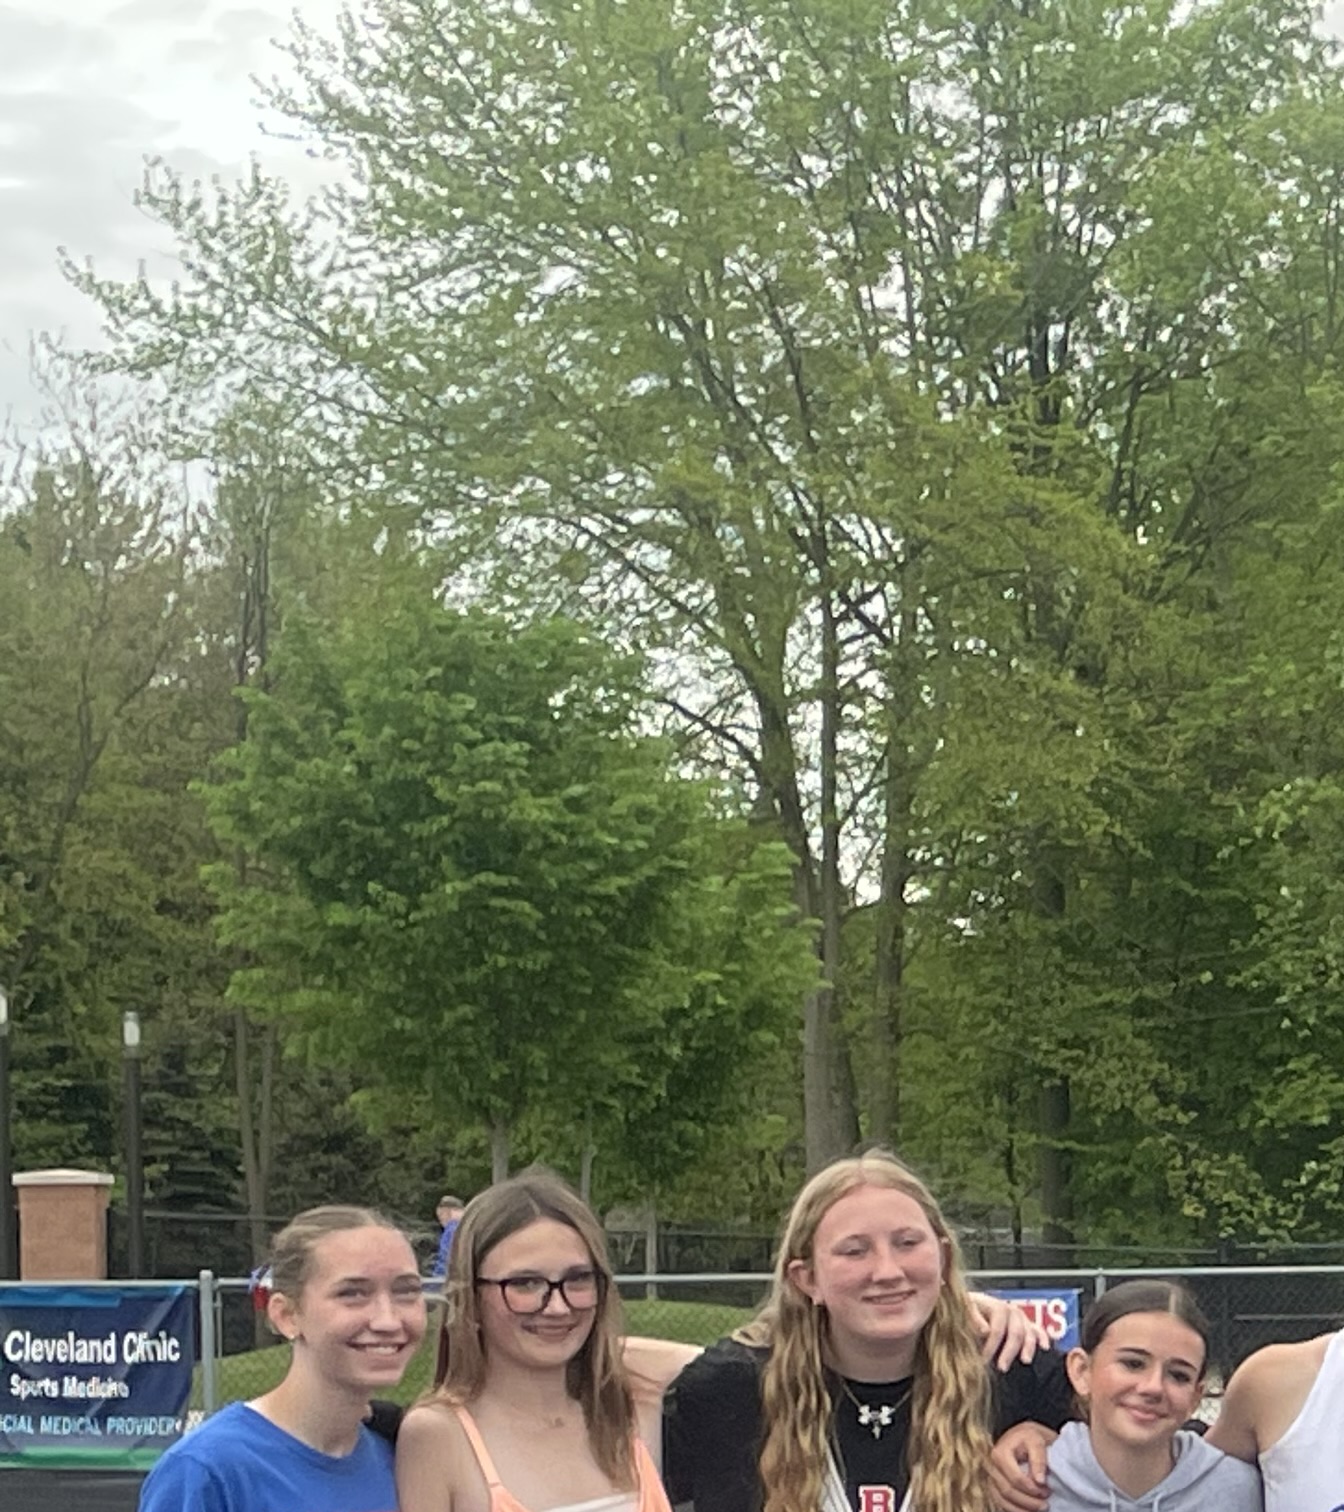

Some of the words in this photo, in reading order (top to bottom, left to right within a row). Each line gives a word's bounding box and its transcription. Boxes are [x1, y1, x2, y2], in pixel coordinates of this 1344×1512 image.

[4, 1330, 117, 1364] Cleveland
[123, 1331, 181, 1364] Clinic
[10, 1373, 58, 1400] Sports
[62, 1376, 130, 1398] Medicine
[0, 1413, 33, 1434] CIAL
[40, 1416, 102, 1435] MEDICAL
[107, 1416, 175, 1436] PROVIDER
